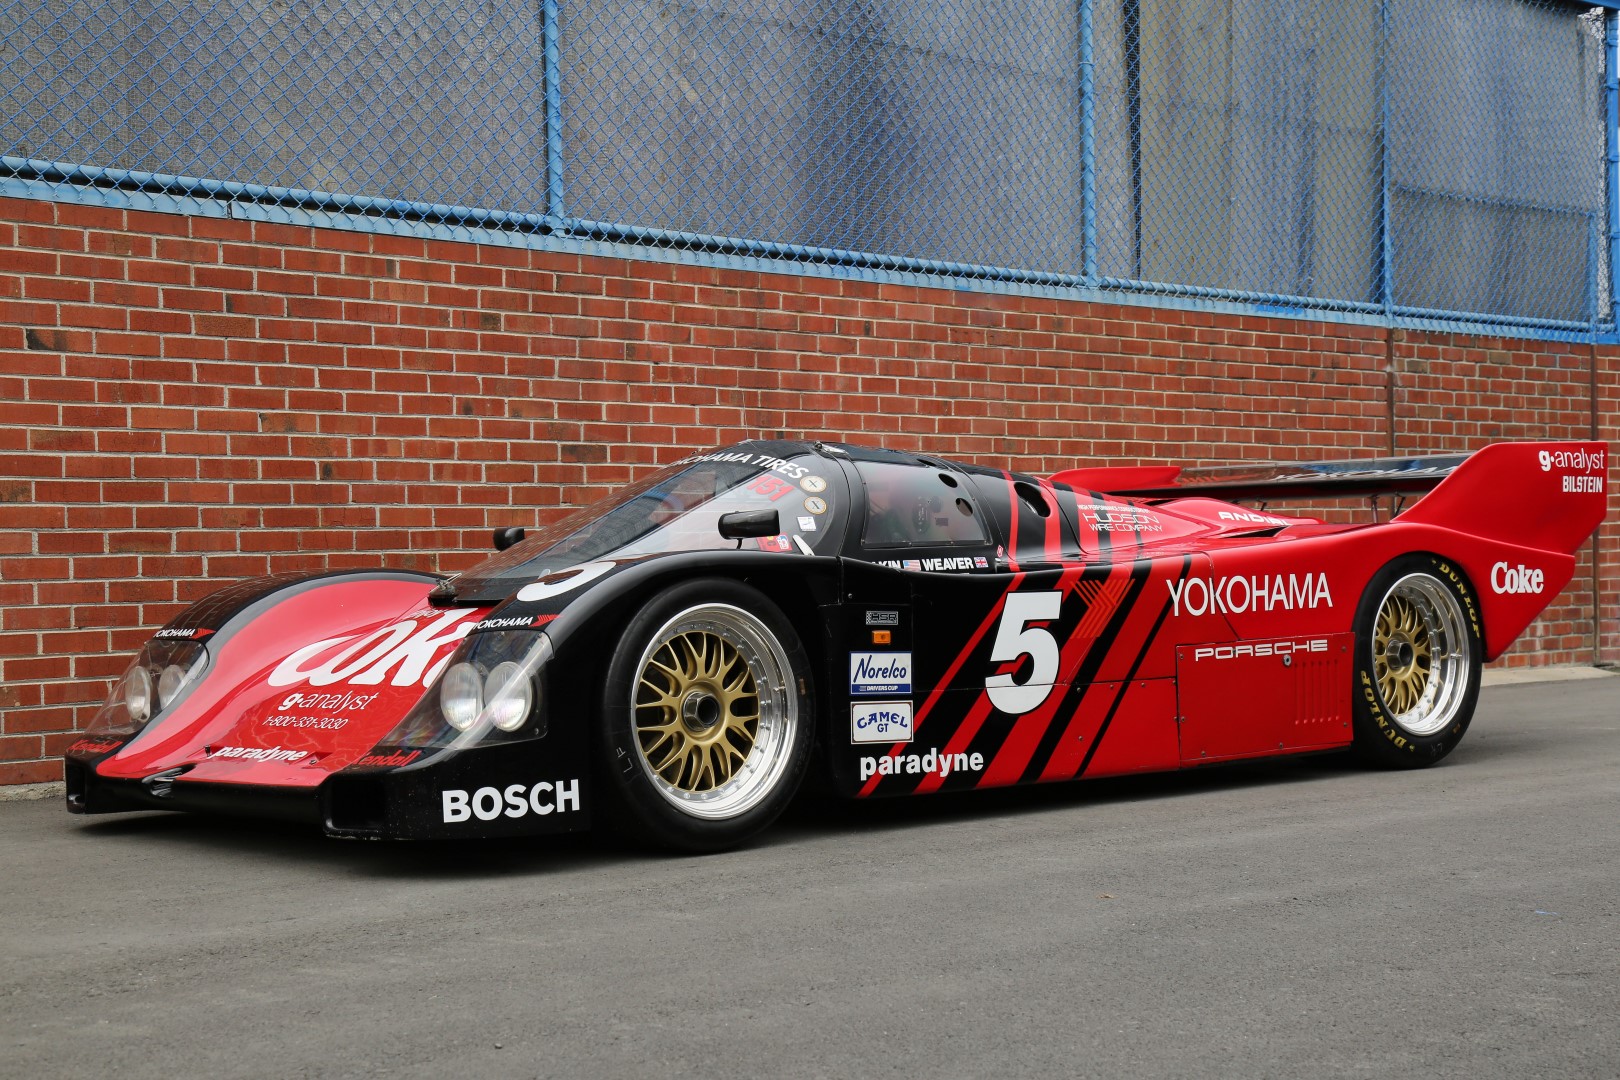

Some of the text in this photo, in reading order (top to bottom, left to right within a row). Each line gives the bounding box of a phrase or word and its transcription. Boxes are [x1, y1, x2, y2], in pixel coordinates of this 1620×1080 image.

[751, 455, 810, 479] TIRES
[746, 473, 796, 502] 151
[1562, 475, 1603, 493] BILSTEIN
[1082, 512, 1160, 524] HUDSON
[1115, 523, 1163, 532] COMPANY
[1218, 511, 1291, 525] ANDIAL
[921, 557, 975, 571] WEAVER
[1490, 561, 1544, 594] Coke
[1166, 572, 1334, 617] YOKOHAMA
[1439, 563, 1480, 639] DUNLOP
[871, 613, 897, 621] HSR
[984, 590, 1062, 714] 5
[1194, 639, 1328, 662] PORSCHE
[853, 654, 907, 683] Norelco
[856, 711, 908, 729] CAMEL
[1360, 670, 1408, 750] DUNLOP
[262, 715, 349, 730] 1-800-331-3030
[877, 723, 889, 733] GT
[207, 746, 309, 763] paradyne
[860, 747, 984, 781] paradyne
[442, 778, 580, 824] BOSCH
